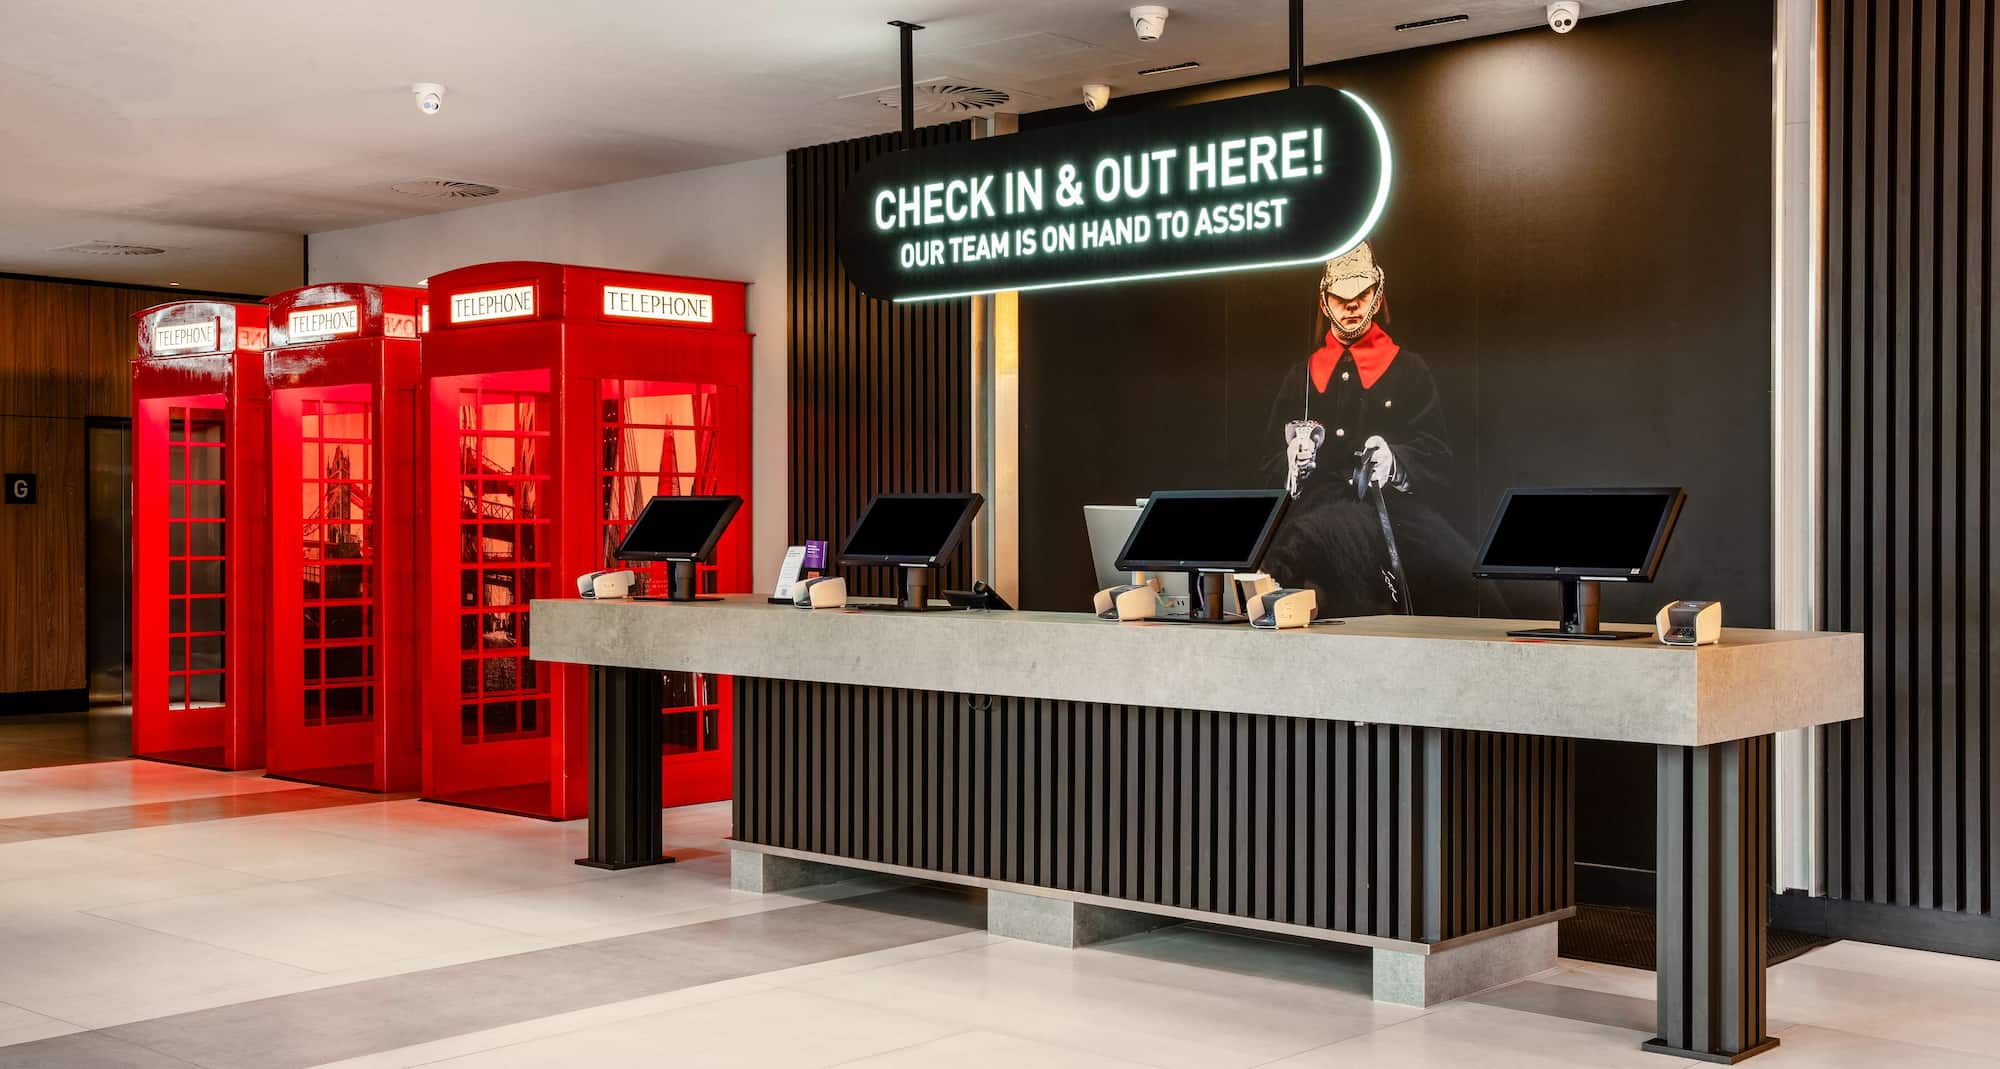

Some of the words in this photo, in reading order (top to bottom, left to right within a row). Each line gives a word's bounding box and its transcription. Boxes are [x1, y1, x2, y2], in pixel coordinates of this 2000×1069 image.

[875, 175, 995, 230] CHECK
[1005, 168, 1042, 214] IN
[1055, 164, 1084, 207] &
[1095, 149, 1177, 202] OUT
[1189, 128, 1323, 191] HERE!
[901, 239, 944, 268] OUR
[949, 231, 1009, 263] TEAM
[1016, 228, 1036, 256] IS
[1042, 223, 1075, 253] ON
[1082, 215, 1150, 248] HAND
[1157, 210, 1189, 240] TO
[1195, 198, 1288, 236] ASSIST
[455, 291, 532, 319] TELEPHONE
[607, 290, 709, 318] TELEPHONE
[292, 309, 356, 335] TELEPHONE
[158, 326, 213, 347] TELEPHONE
[14, 480, 28, 498] G
